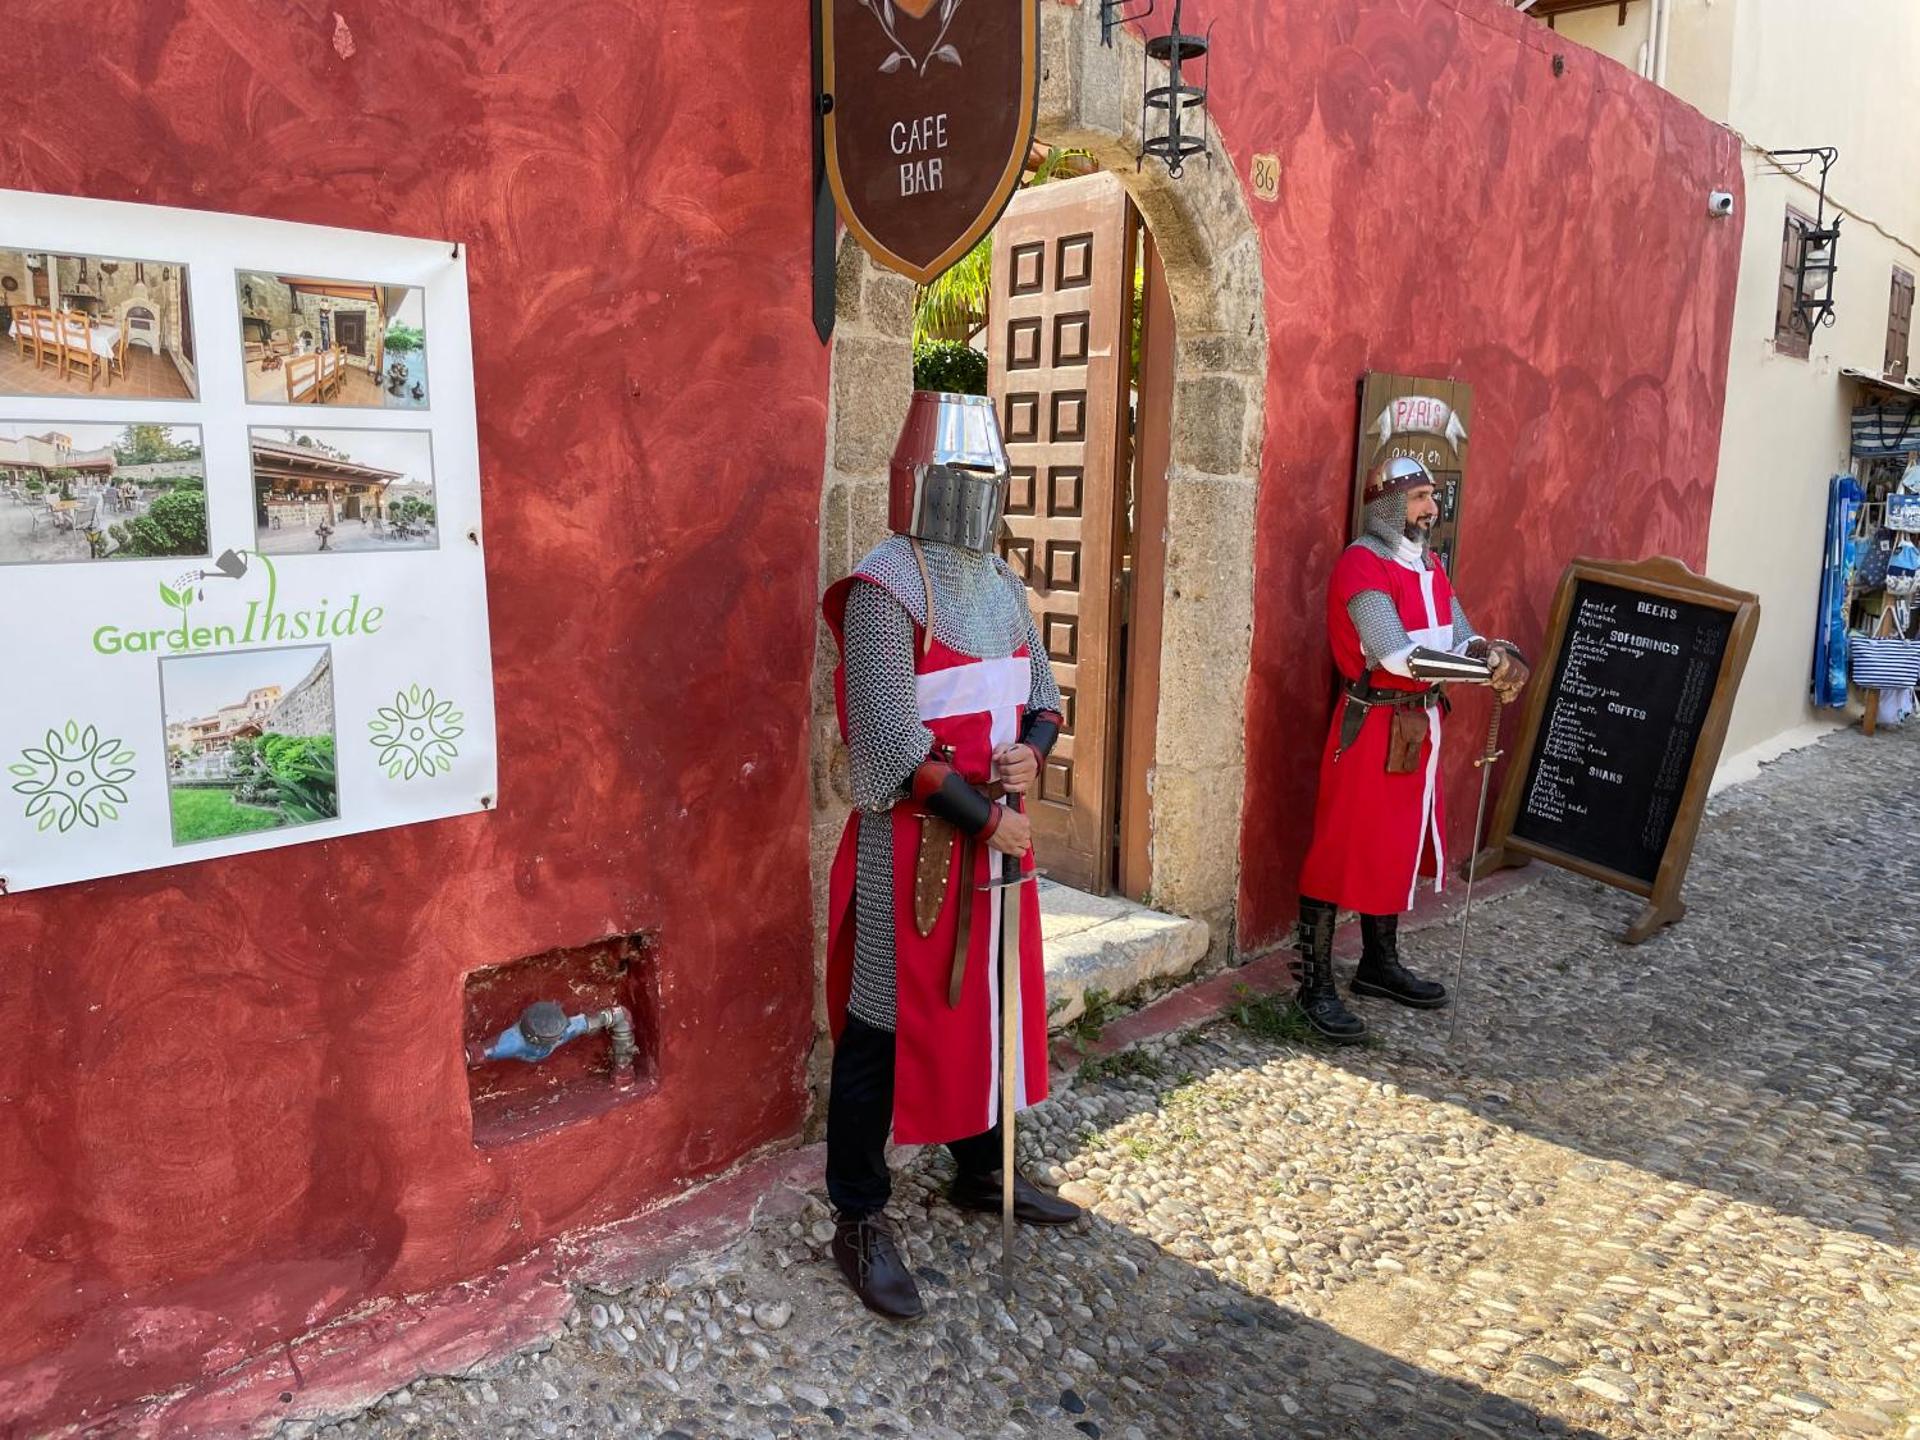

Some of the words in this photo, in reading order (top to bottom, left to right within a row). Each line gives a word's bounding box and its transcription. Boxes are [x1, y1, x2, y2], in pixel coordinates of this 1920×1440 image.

[890, 113, 948, 154] CAFE
[900, 158, 943, 196] BAR
[1256, 161, 1274, 191] 86
[1637, 601, 1677, 620] BEERS
[92, 610, 235, 655] Garden
